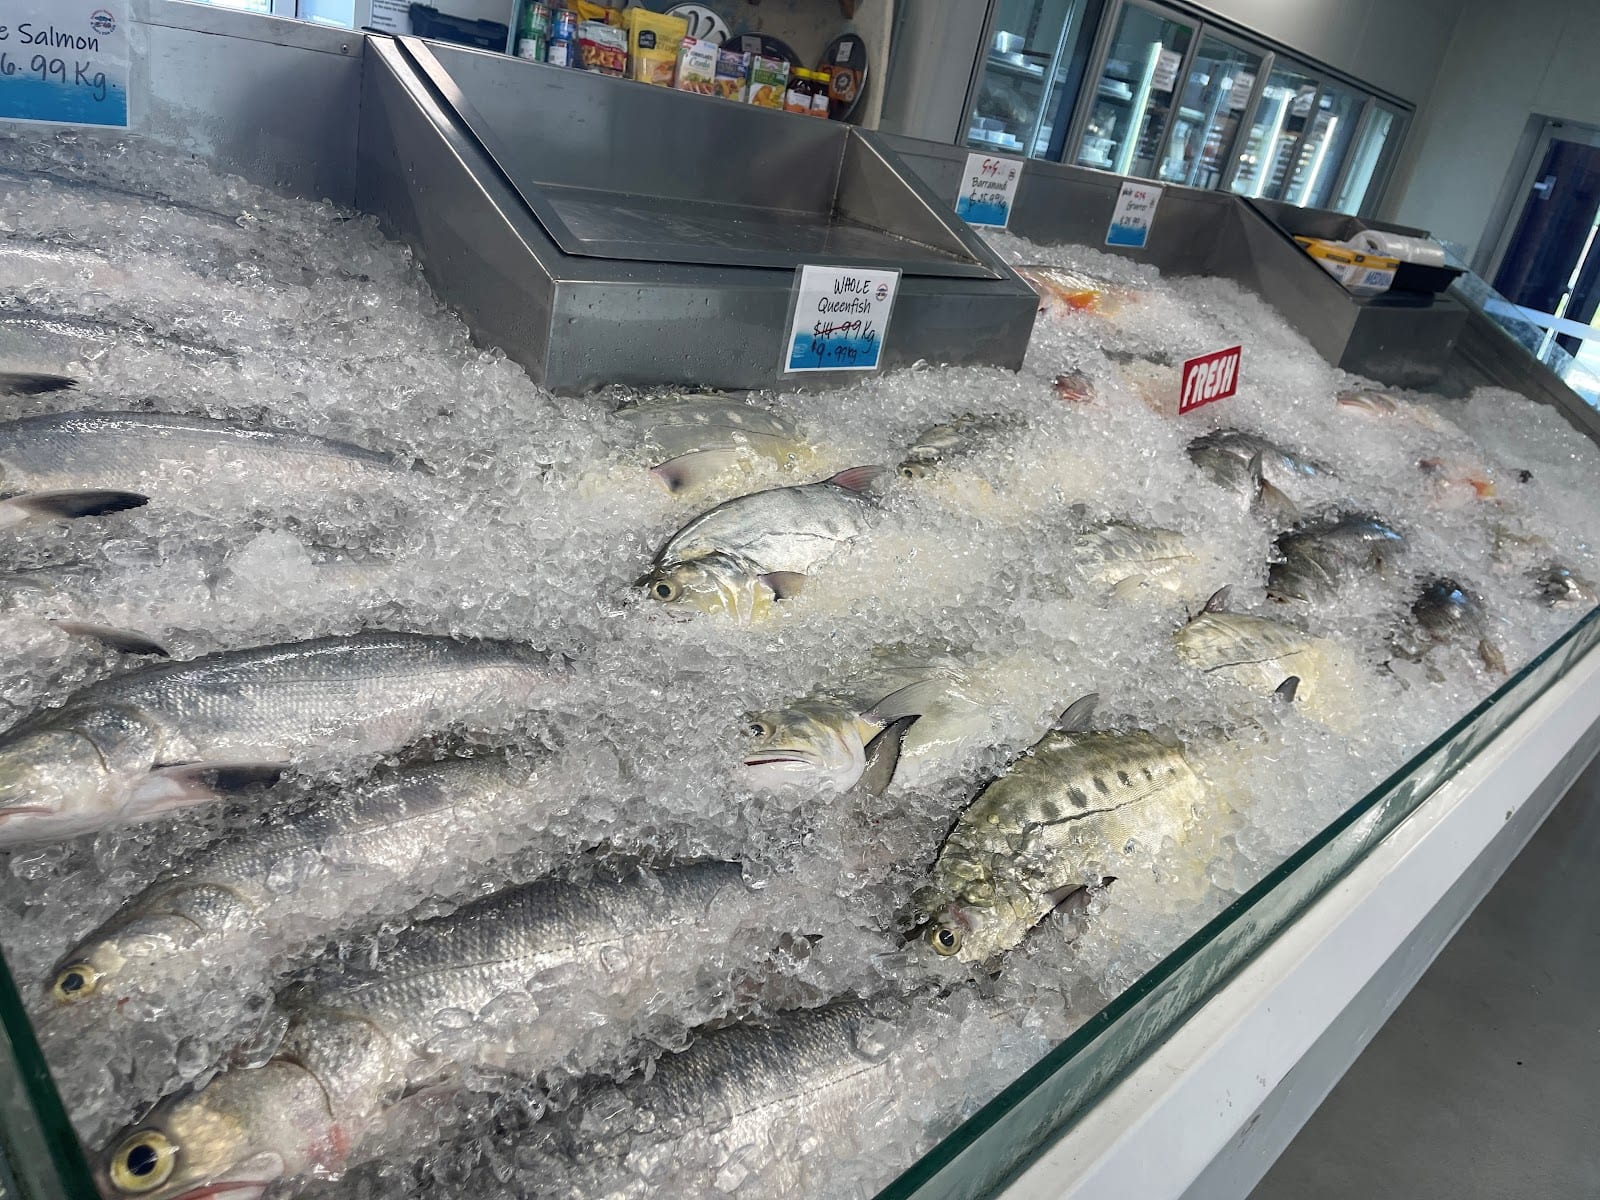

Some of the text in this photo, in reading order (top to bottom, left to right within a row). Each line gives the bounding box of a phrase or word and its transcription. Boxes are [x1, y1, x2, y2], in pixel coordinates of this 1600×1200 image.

[18, 23, 99, 52] Salmon
[833, 276, 871, 295] WHOLE
[817, 297, 871, 314] Queenfish
[1181, 352, 1239, 408] FRESH
